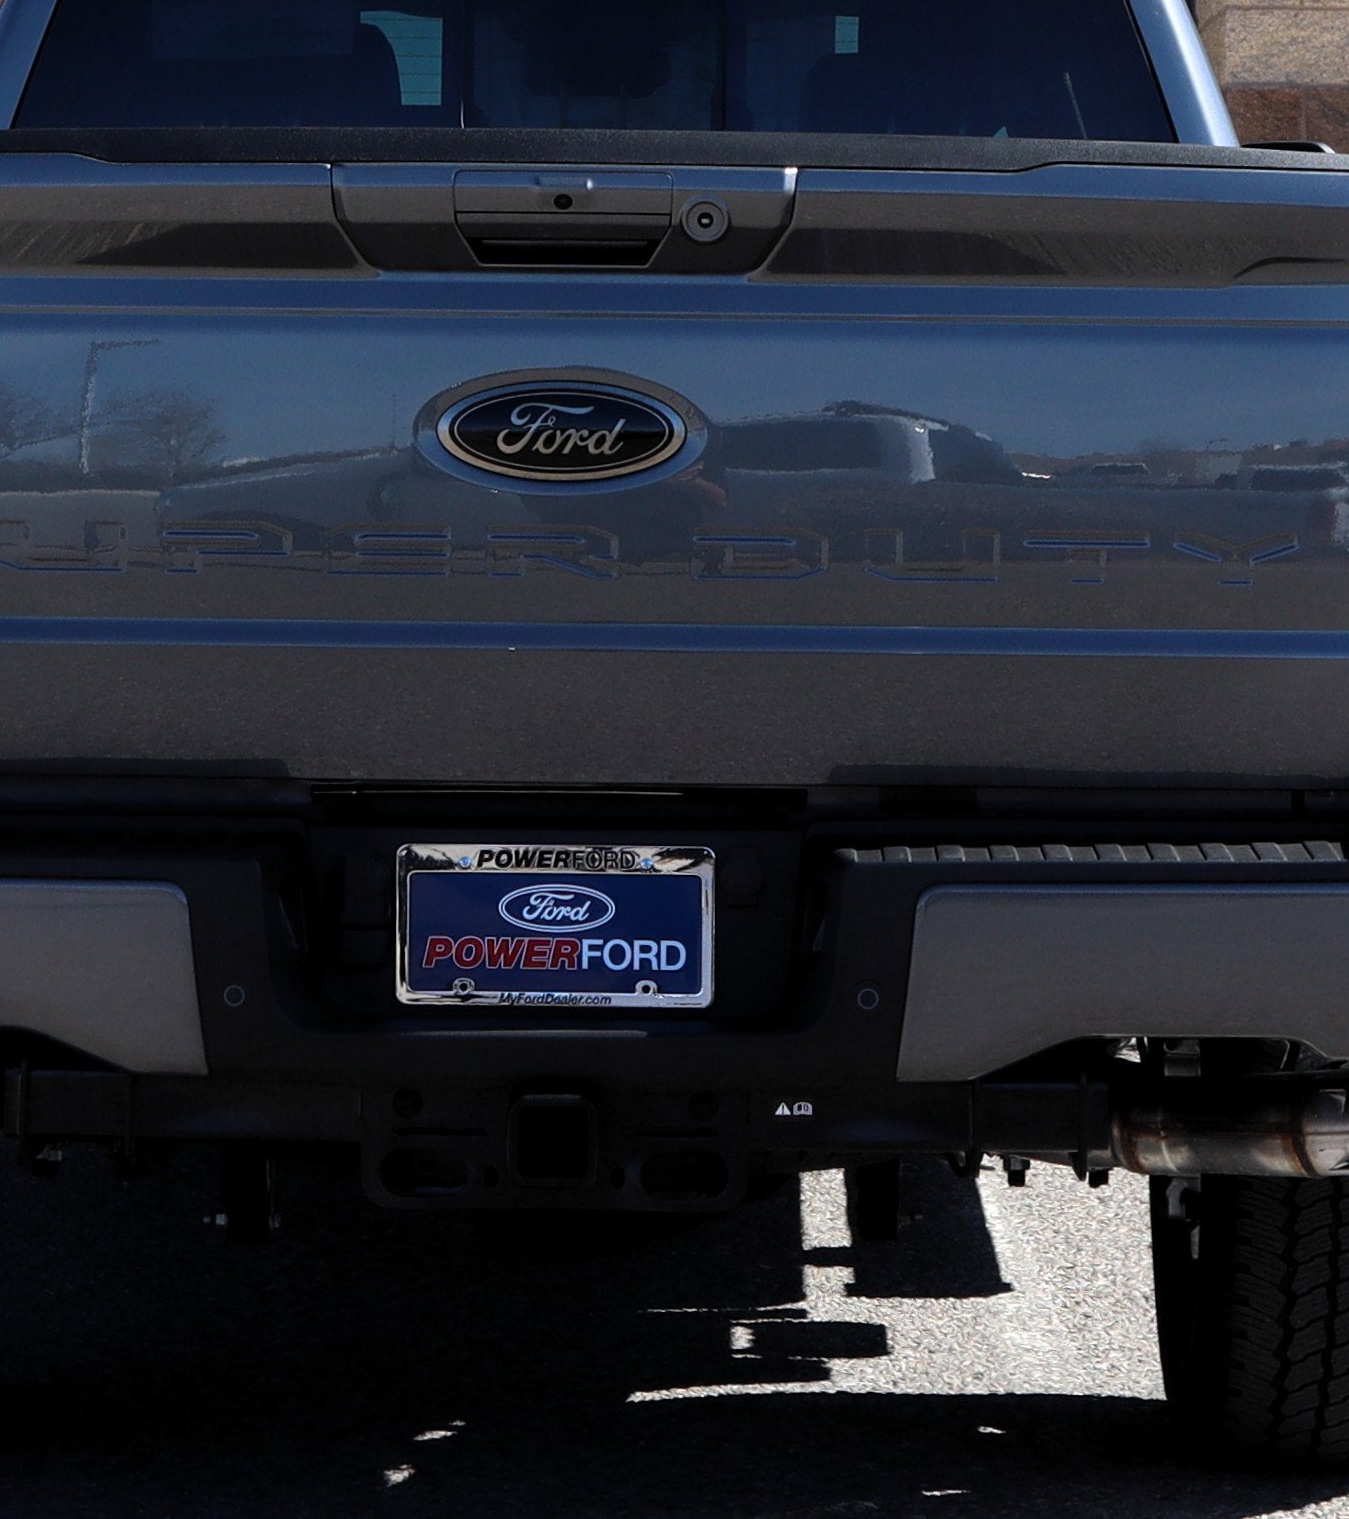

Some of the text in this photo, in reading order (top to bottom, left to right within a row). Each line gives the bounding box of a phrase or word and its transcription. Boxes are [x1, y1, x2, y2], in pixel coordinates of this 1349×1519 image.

[496, 402, 627, 456] Ford
[692, 526, 1299, 585] DUTY
[477, 848, 637, 870] POWERFORD
[522, 892, 591, 922] Ford
[422, 935, 687, 972] POWERFORD
[498, 992, 612, 1006] MyFordDealer.com
